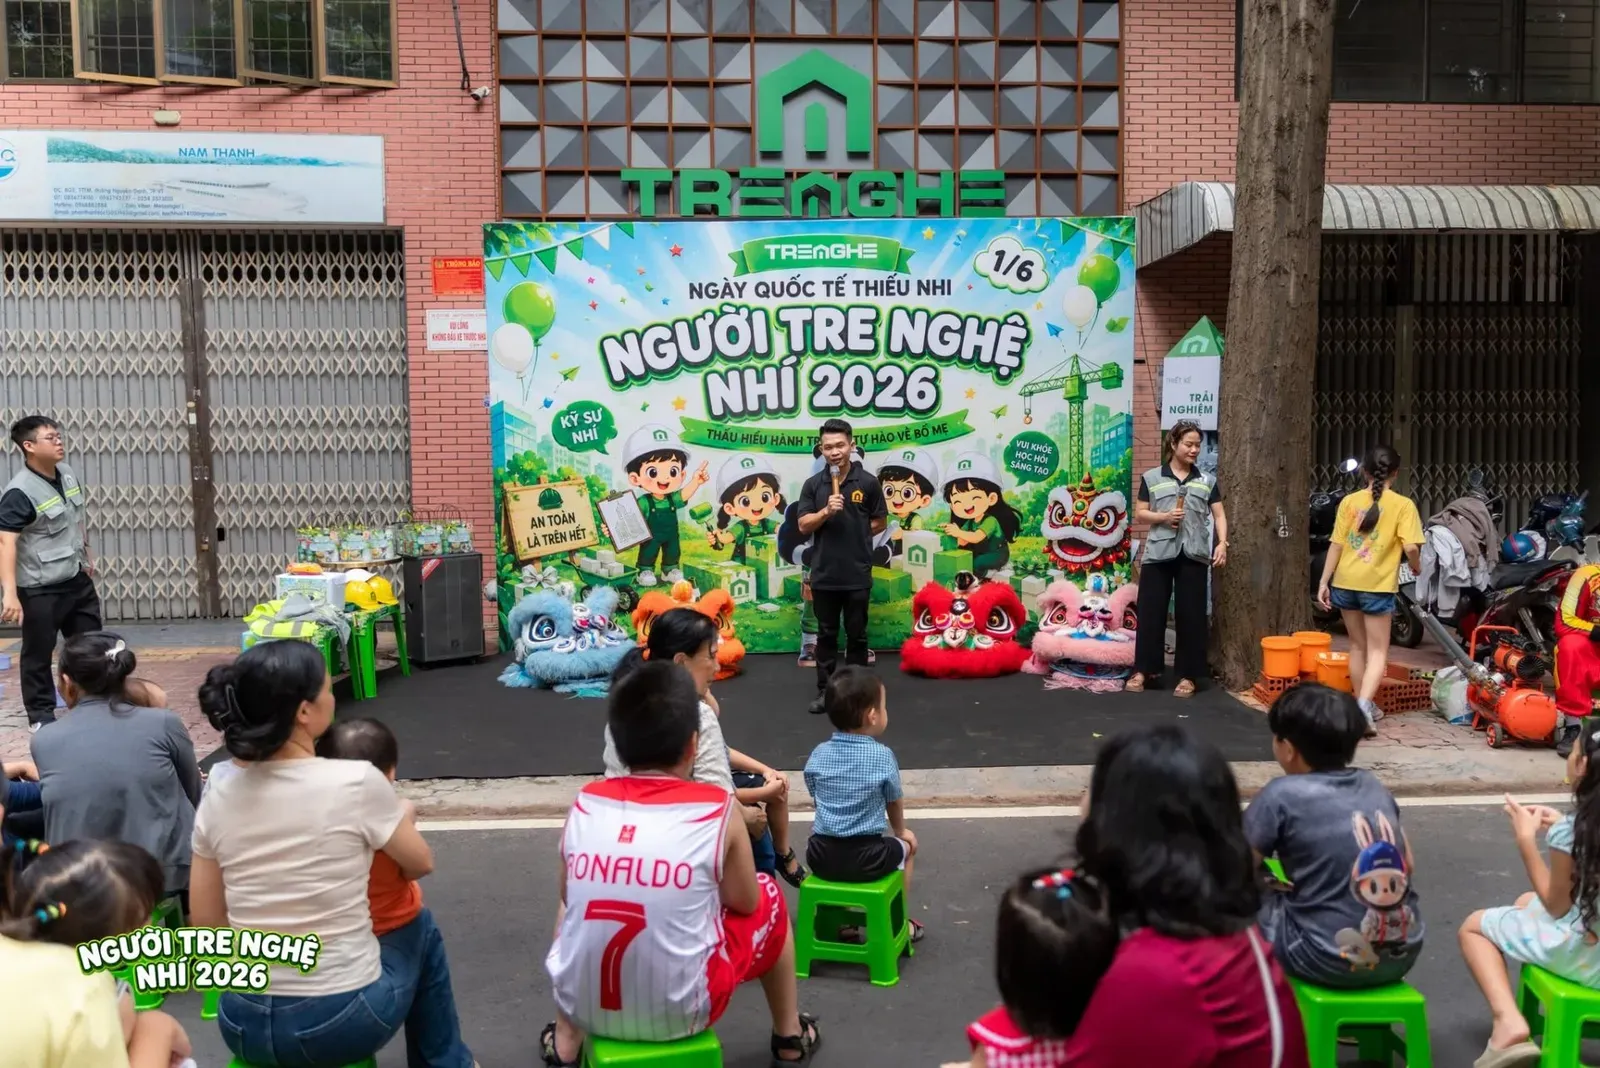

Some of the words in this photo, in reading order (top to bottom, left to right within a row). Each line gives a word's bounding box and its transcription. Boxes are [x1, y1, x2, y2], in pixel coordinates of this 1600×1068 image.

[178, 147, 208, 157] NAM
[212, 147, 255, 158] THANH
[993, 249, 1034, 282] 1/6
[689, 276, 748, 300] NGÀY
[754, 273, 816, 299] QUỐC
[822, 273, 848, 298] TẾ
[852, 272, 910, 297] THIẾU
[916, 279, 951, 297] NHI
[602, 306, 768, 383] NGƯỜI
[777, 308, 875, 353] TRE
[890, 309, 1030, 378] NGHỆ
[706, 355, 799, 417] NHÍ
[810, 363, 937, 410] 2026
[1189, 390, 1214, 402] TRẢI
[560, 410, 580, 429] KỸ
[583, 408, 603, 424] SƯ
[1169, 403, 1213, 416] NGHIỆM
[571, 425, 598, 444] NHÍ
[706, 427, 738, 443] THẤU
[741, 430, 767, 445] HIỂU
[770, 431, 803, 447] HÀNH
[853, 433, 869, 447] TỰ
[870, 431, 896, 445] HÀO
[897, 424, 911, 442] VỀ
[914, 422, 929, 439] BỐ
[932, 422, 949, 437] MẸ
[1015, 450, 1033, 462] HỌC
[1033, 453, 1049, 464] HỎI
[1016, 440, 1030, 450] VUI
[1030, 442, 1053, 454] KHỎE
[1010, 459, 1032, 472] SÁNG
[1033, 465, 1049, 476] TẠO
[530, 515, 546, 530] AN
[547, 510, 576, 526] TOÀN
[526, 532, 541, 548] LÀ
[542, 526, 568, 545] TRÊN
[569, 524, 587, 541] HẾT
[583, 898, 647, 1011] 7
